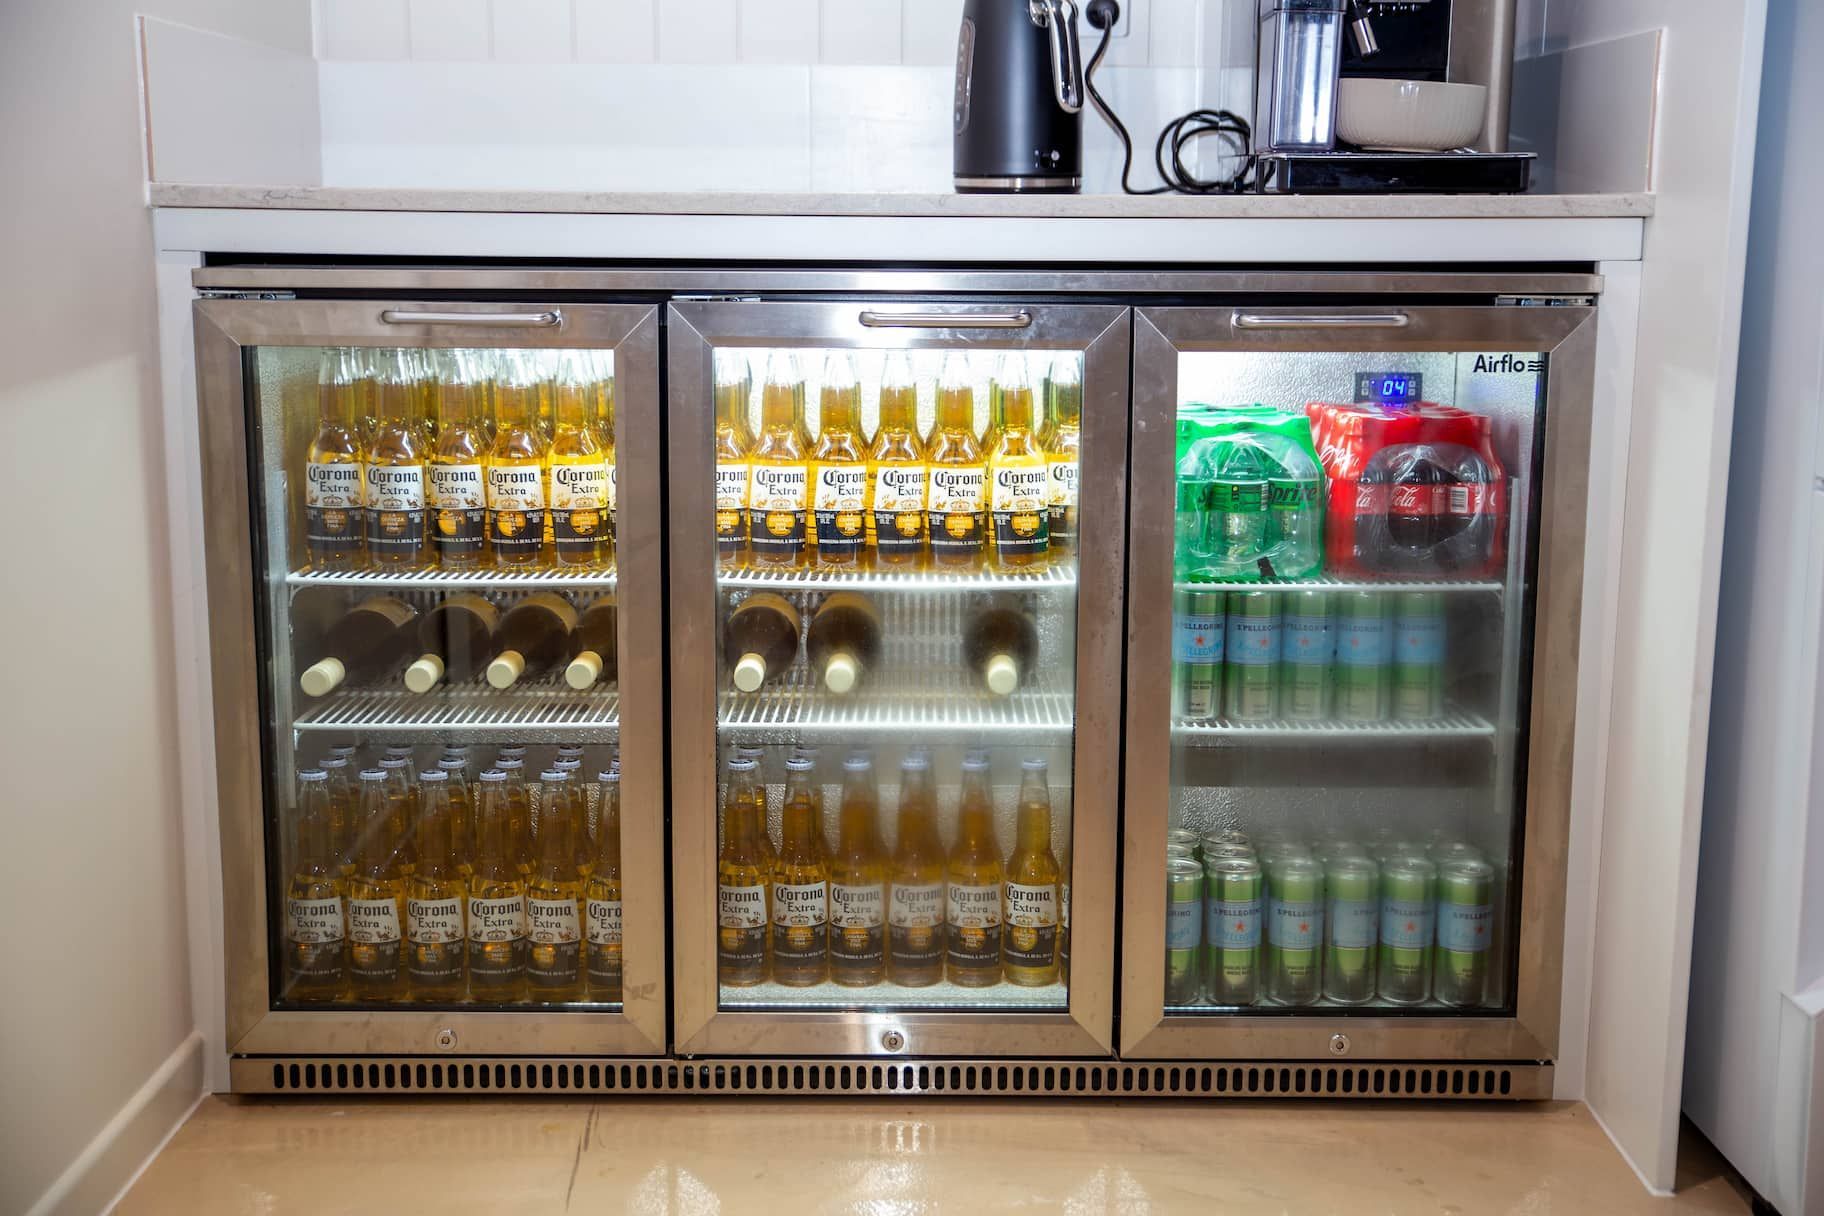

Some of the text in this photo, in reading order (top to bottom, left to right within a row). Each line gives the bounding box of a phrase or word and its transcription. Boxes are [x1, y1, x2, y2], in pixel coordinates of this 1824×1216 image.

[1473, 354, 1525, 373] Airflo
[1382, 380, 1405, 396] 04
[308, 465, 359, 482] Corona
[368, 467, 419, 484] Corona
[430, 465, 477, 484] Corona
[488, 468, 536, 486] Corona
[715, 471, 747, 482] orona
[756, 469, 805, 487] Corona
[934, 471, 982, 488] Corona
[998, 469, 1046, 488] Corona
[319, 481, 350, 492] Extra
[379, 483, 409, 495] Extra
[438, 483, 467, 494] Extra
[497, 484, 526, 495] Extra
[571, 483, 599, 494] Extra
[769, 484, 797, 496] Extra
[948, 486, 975, 497] Extra
[1012, 485, 1040, 496] Extra
[720, 889, 760, 902] orona
[775, 886, 823, 904] Corona
[832, 887, 880, 904] Corona
[951, 886, 998, 903] Corona
[1006, 884, 1050, 901] Corona
[289, 901, 338, 917] Corona
[408, 901, 457, 918] Corona
[471, 901, 521, 918] Corona
[528, 901, 572, 918] Corona
[589, 902, 622, 920] Coro
[722, 902, 749, 914] Extra
[787, 901, 816, 912] Extra
[843, 902, 872, 914] Extra
[960, 902, 988, 914] Extra
[1013, 900, 1041, 913] Extra
[297, 917, 326, 928] Extra
[352, 916, 379, 928] Extra
[418, 916, 447, 928] Extra
[484, 917, 513, 928] Extra
[534, 917, 561, 928] Extra
[600, 918, 622, 929] Extr
